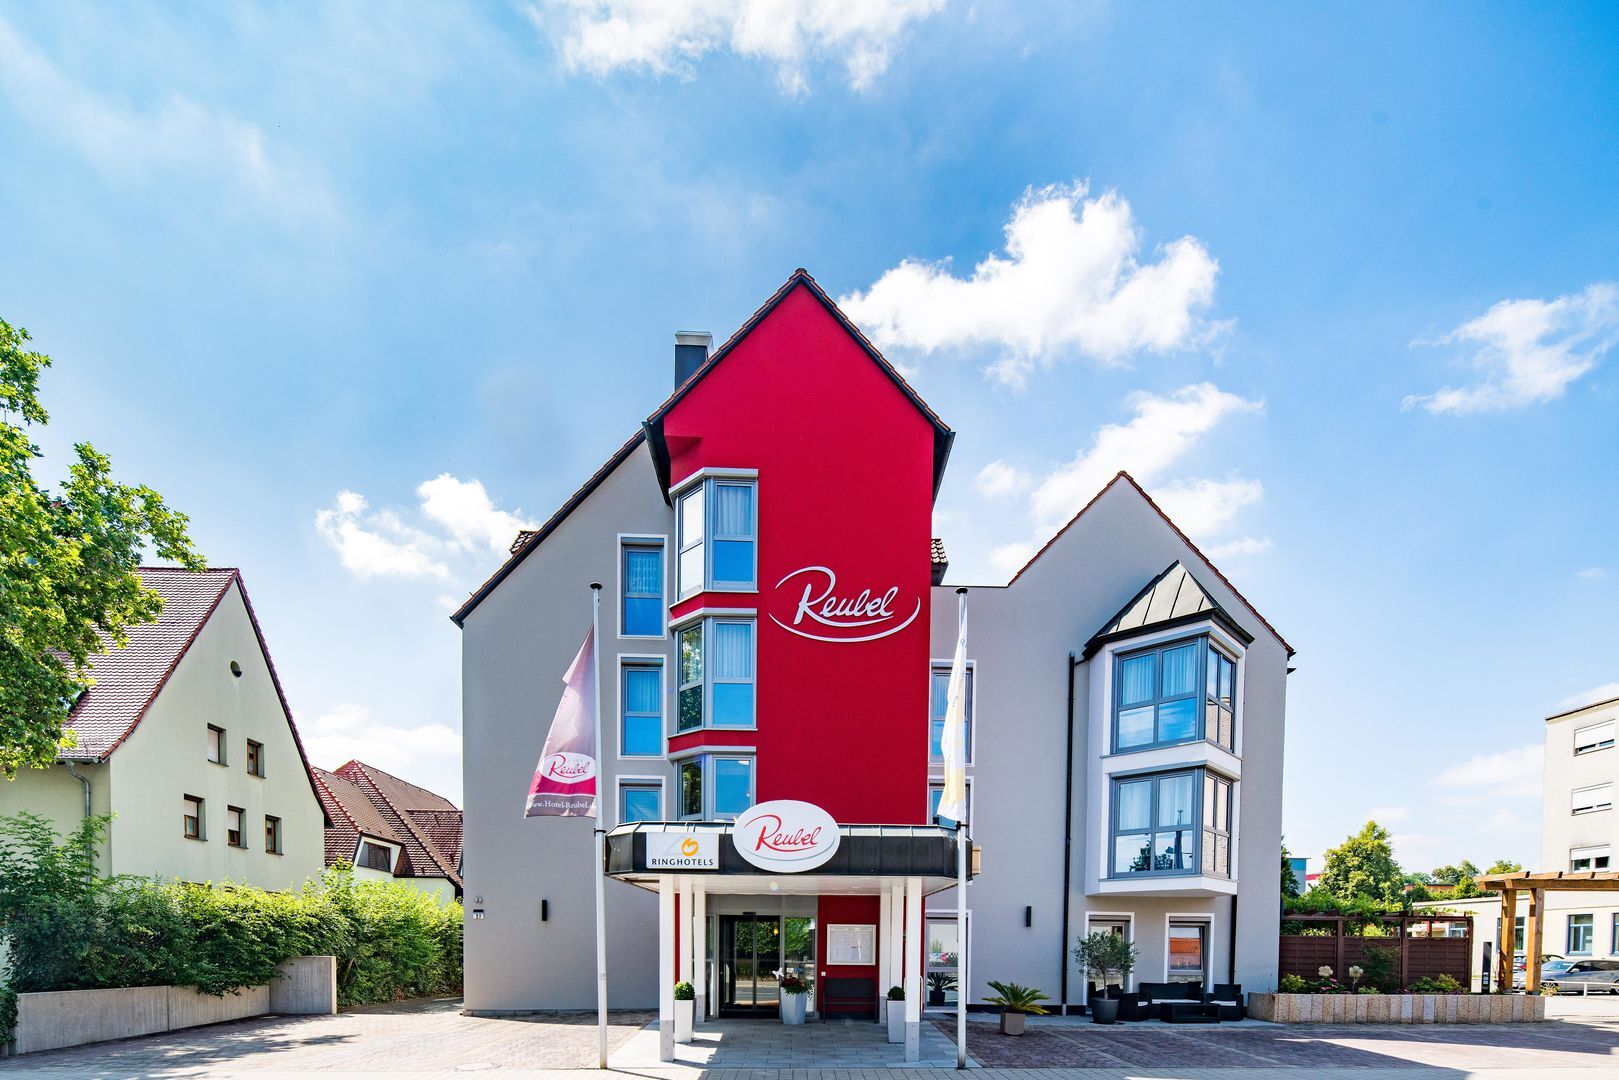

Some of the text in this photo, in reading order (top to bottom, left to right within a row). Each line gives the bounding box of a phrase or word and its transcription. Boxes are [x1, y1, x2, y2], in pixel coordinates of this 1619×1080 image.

[775, 566, 898, 627] Reubel
[546, 754, 590, 779] Reubel
[744, 814, 822, 853] Reubel
[651, 858, 714, 866] RINGHOTELS
